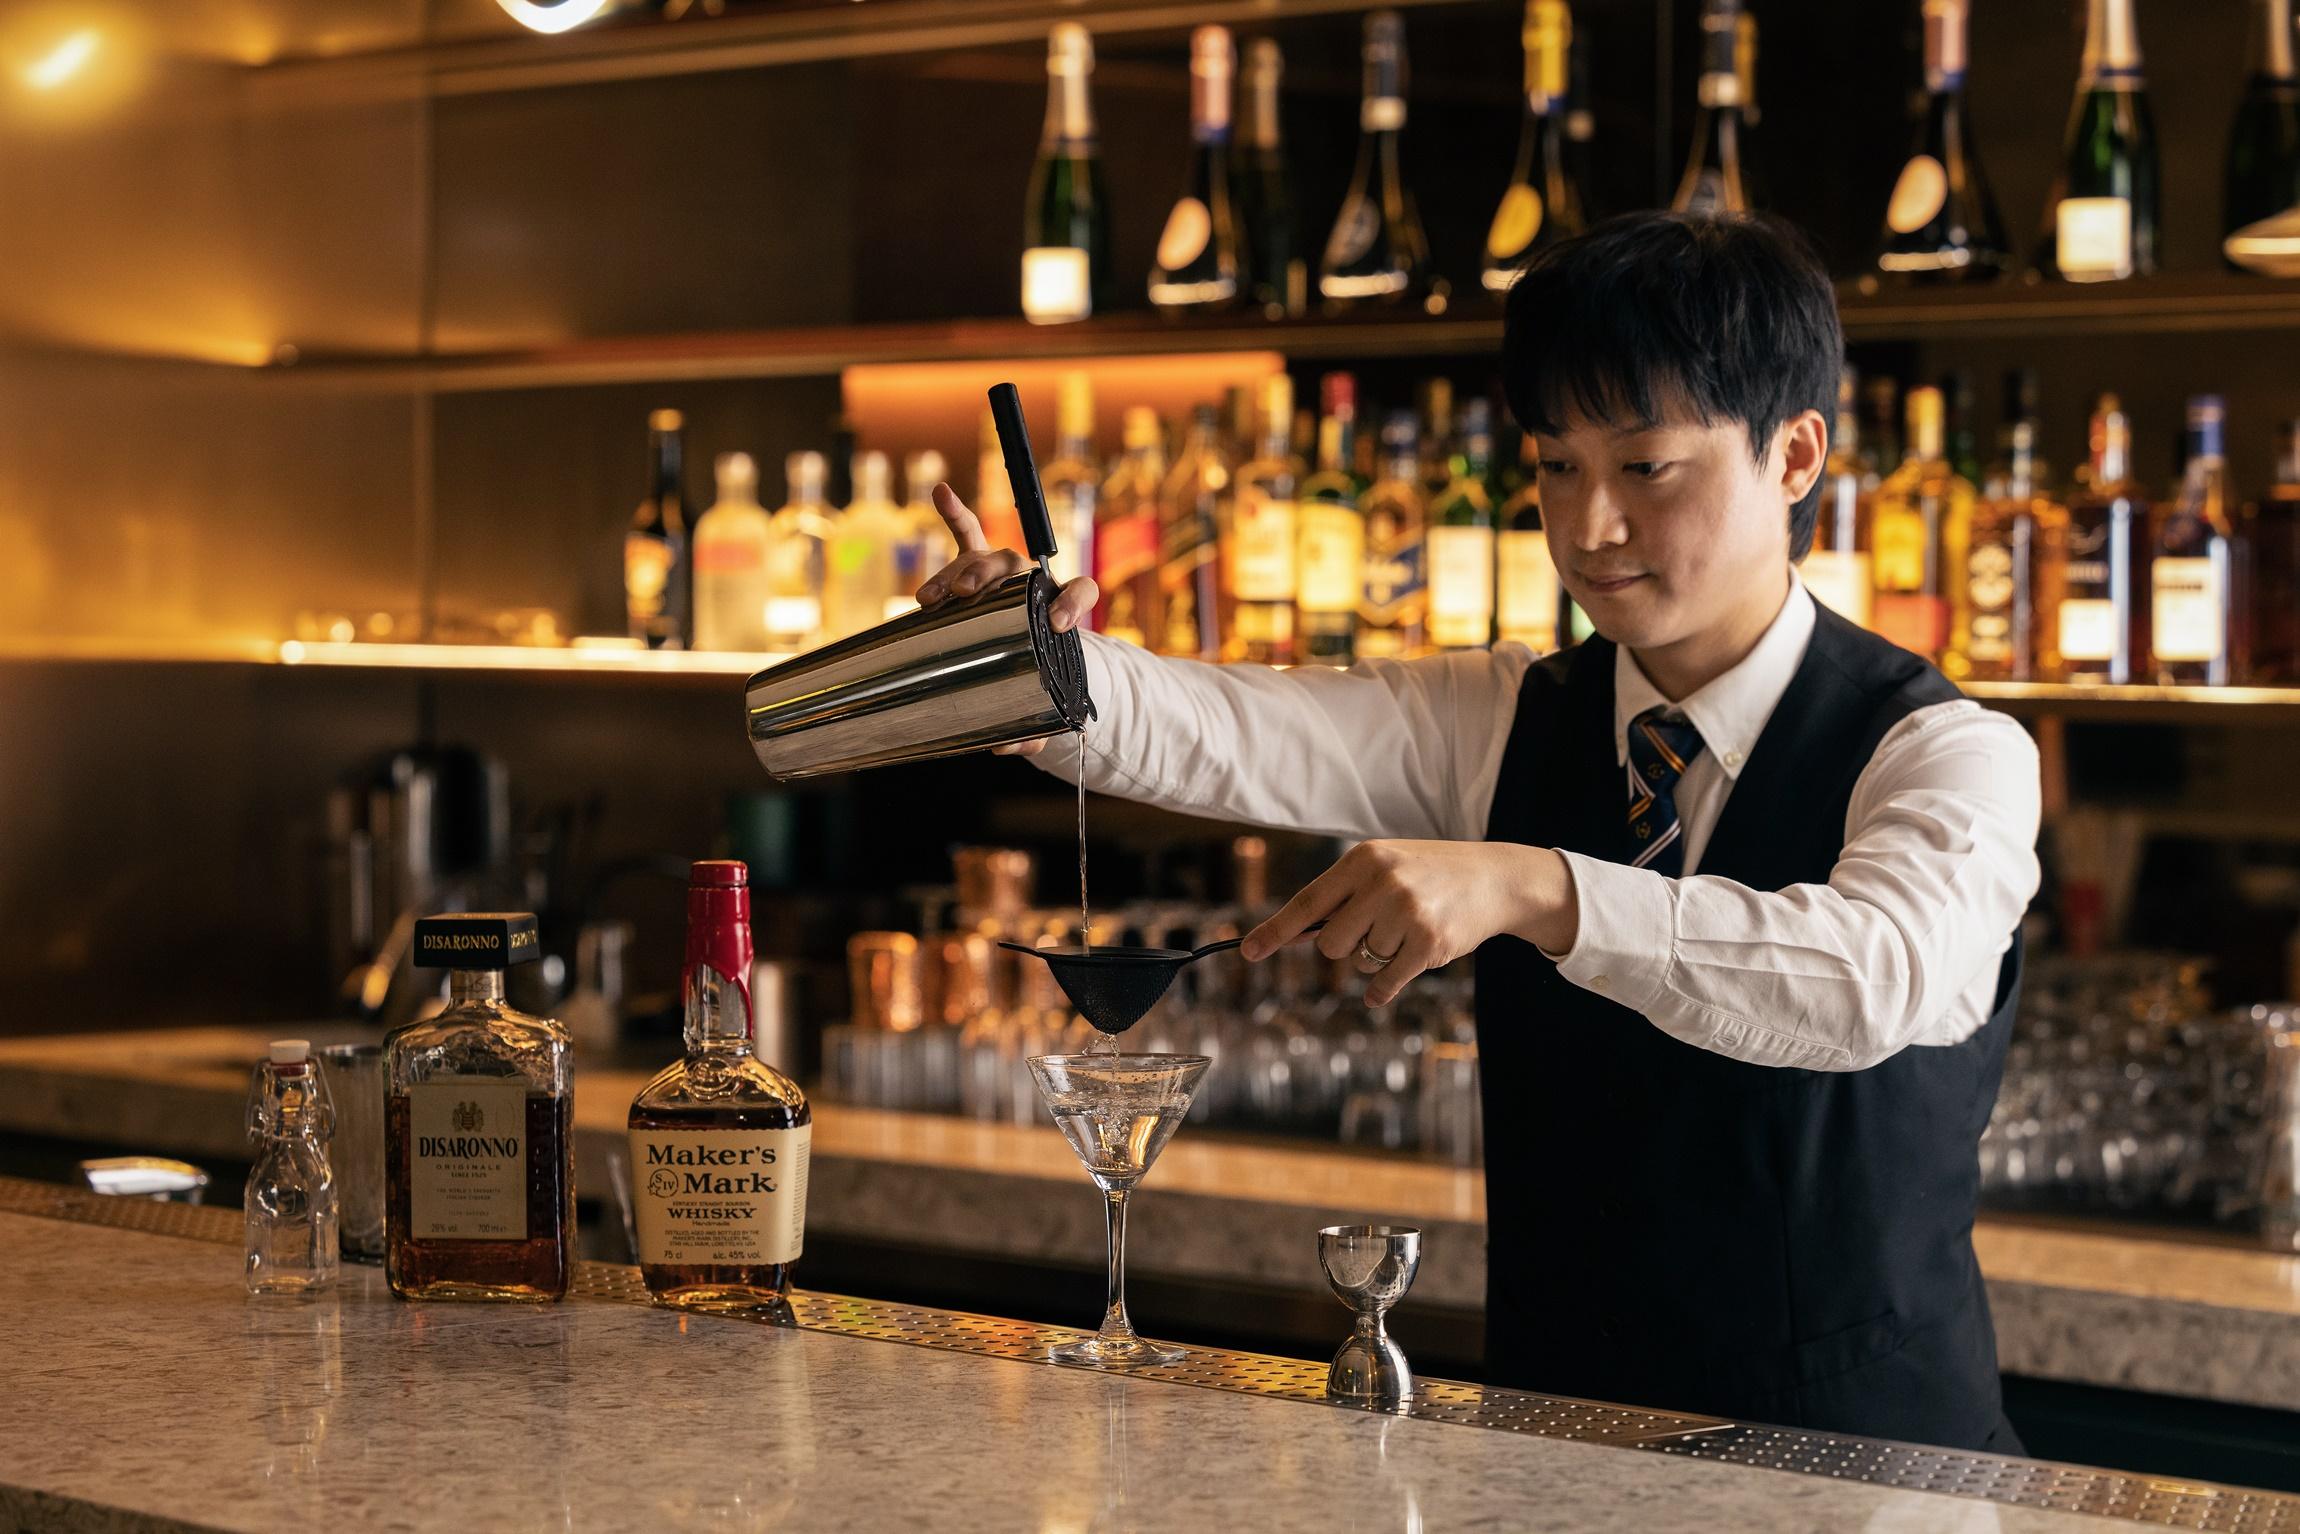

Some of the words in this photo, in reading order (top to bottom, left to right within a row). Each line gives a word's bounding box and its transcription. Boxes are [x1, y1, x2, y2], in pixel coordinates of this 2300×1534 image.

[423, 934, 500, 951] DISARONNO
[419, 1136, 518, 1159] DISARONNO
[646, 1143, 777, 1166] Maker's
[655, 1173, 663, 1184] S
[683, 1172, 777, 1194] Mark
[663, 1181, 676, 1191] IV
[667, 1207, 758, 1219] WHISKY
[663, 1250, 674, 1259] 75
[728, 1250, 745, 1259] 45%
